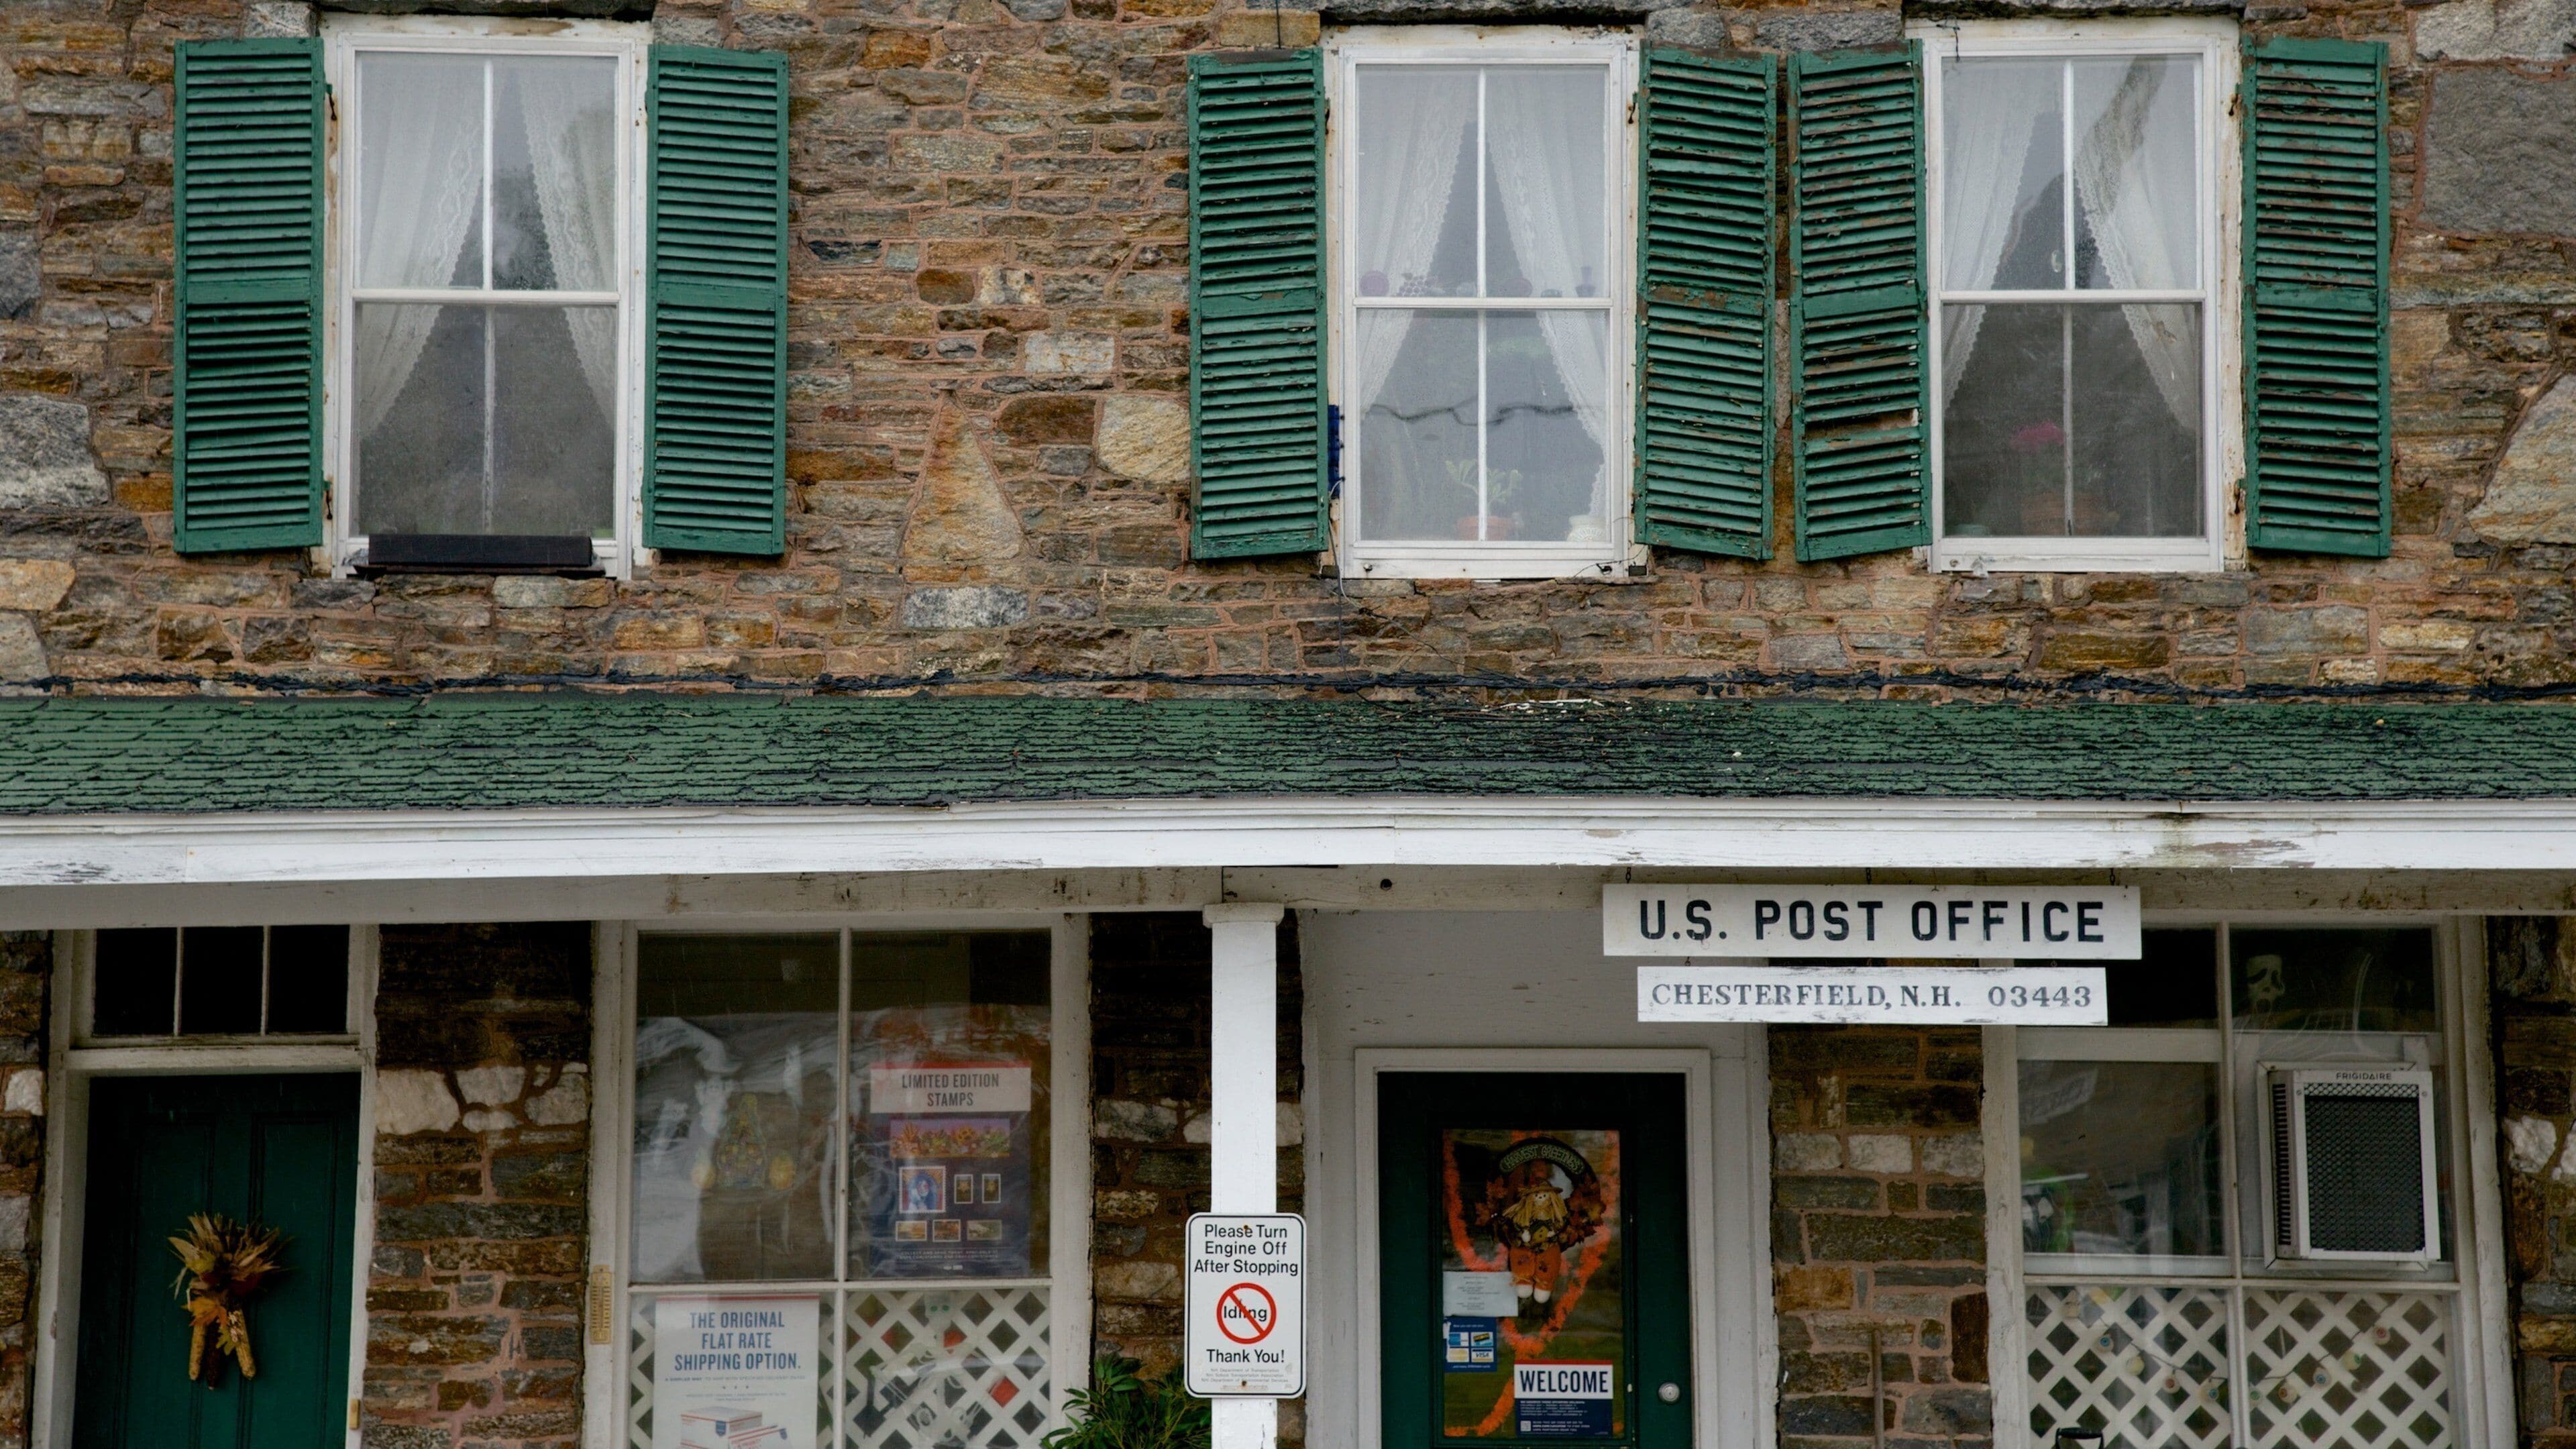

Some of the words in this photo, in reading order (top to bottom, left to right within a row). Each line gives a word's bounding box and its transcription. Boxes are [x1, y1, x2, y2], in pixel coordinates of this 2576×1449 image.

[1639, 900, 1728, 940] U.S.
[1755, 900, 1883, 941] POST
[1911, 900, 2104, 943] OFFICE
[1652, 983, 1892, 1010] CHESTERFIELD,
[1899, 985, 1962, 1008] N.H.
[1988, 985, 2092, 1008] 03443
[902, 1074, 949, 1089] LIMITED
[953, 1073, 999, 1088] EDITION
[2336, 1072, 2392, 1080] FRIGIDAIRE
[927, 1092, 973, 1107] STAMPS
[1504, 1144, 1539, 1169] HARVEST
[1540, 1144, 1580, 1171] GREETINGS
[1204, 1224, 1253, 1238] Please
[1256, 1224, 1287, 1238] Turn
[1205, 1241, 1256, 1257] Engine
[1263, 1241, 1287, 1255] Off
[1194, 1259, 1230, 1273] After
[1233, 1259, 1298, 1277] Stopping
[690, 1312, 716, 1328] THE
[720, 1311, 785, 1328] ORIGINAL
[702, 1332, 734, 1350] FLAT
[739, 1332, 772, 1348] RATE
[674, 1354, 741, 1371] SHIPPING
[745, 1352, 801, 1370] OPTION.
[1206, 1349, 1250, 1362] Thank
[1254, 1349, 1285, 1362] You!
[1519, 1370, 1609, 1393] WELCOME
